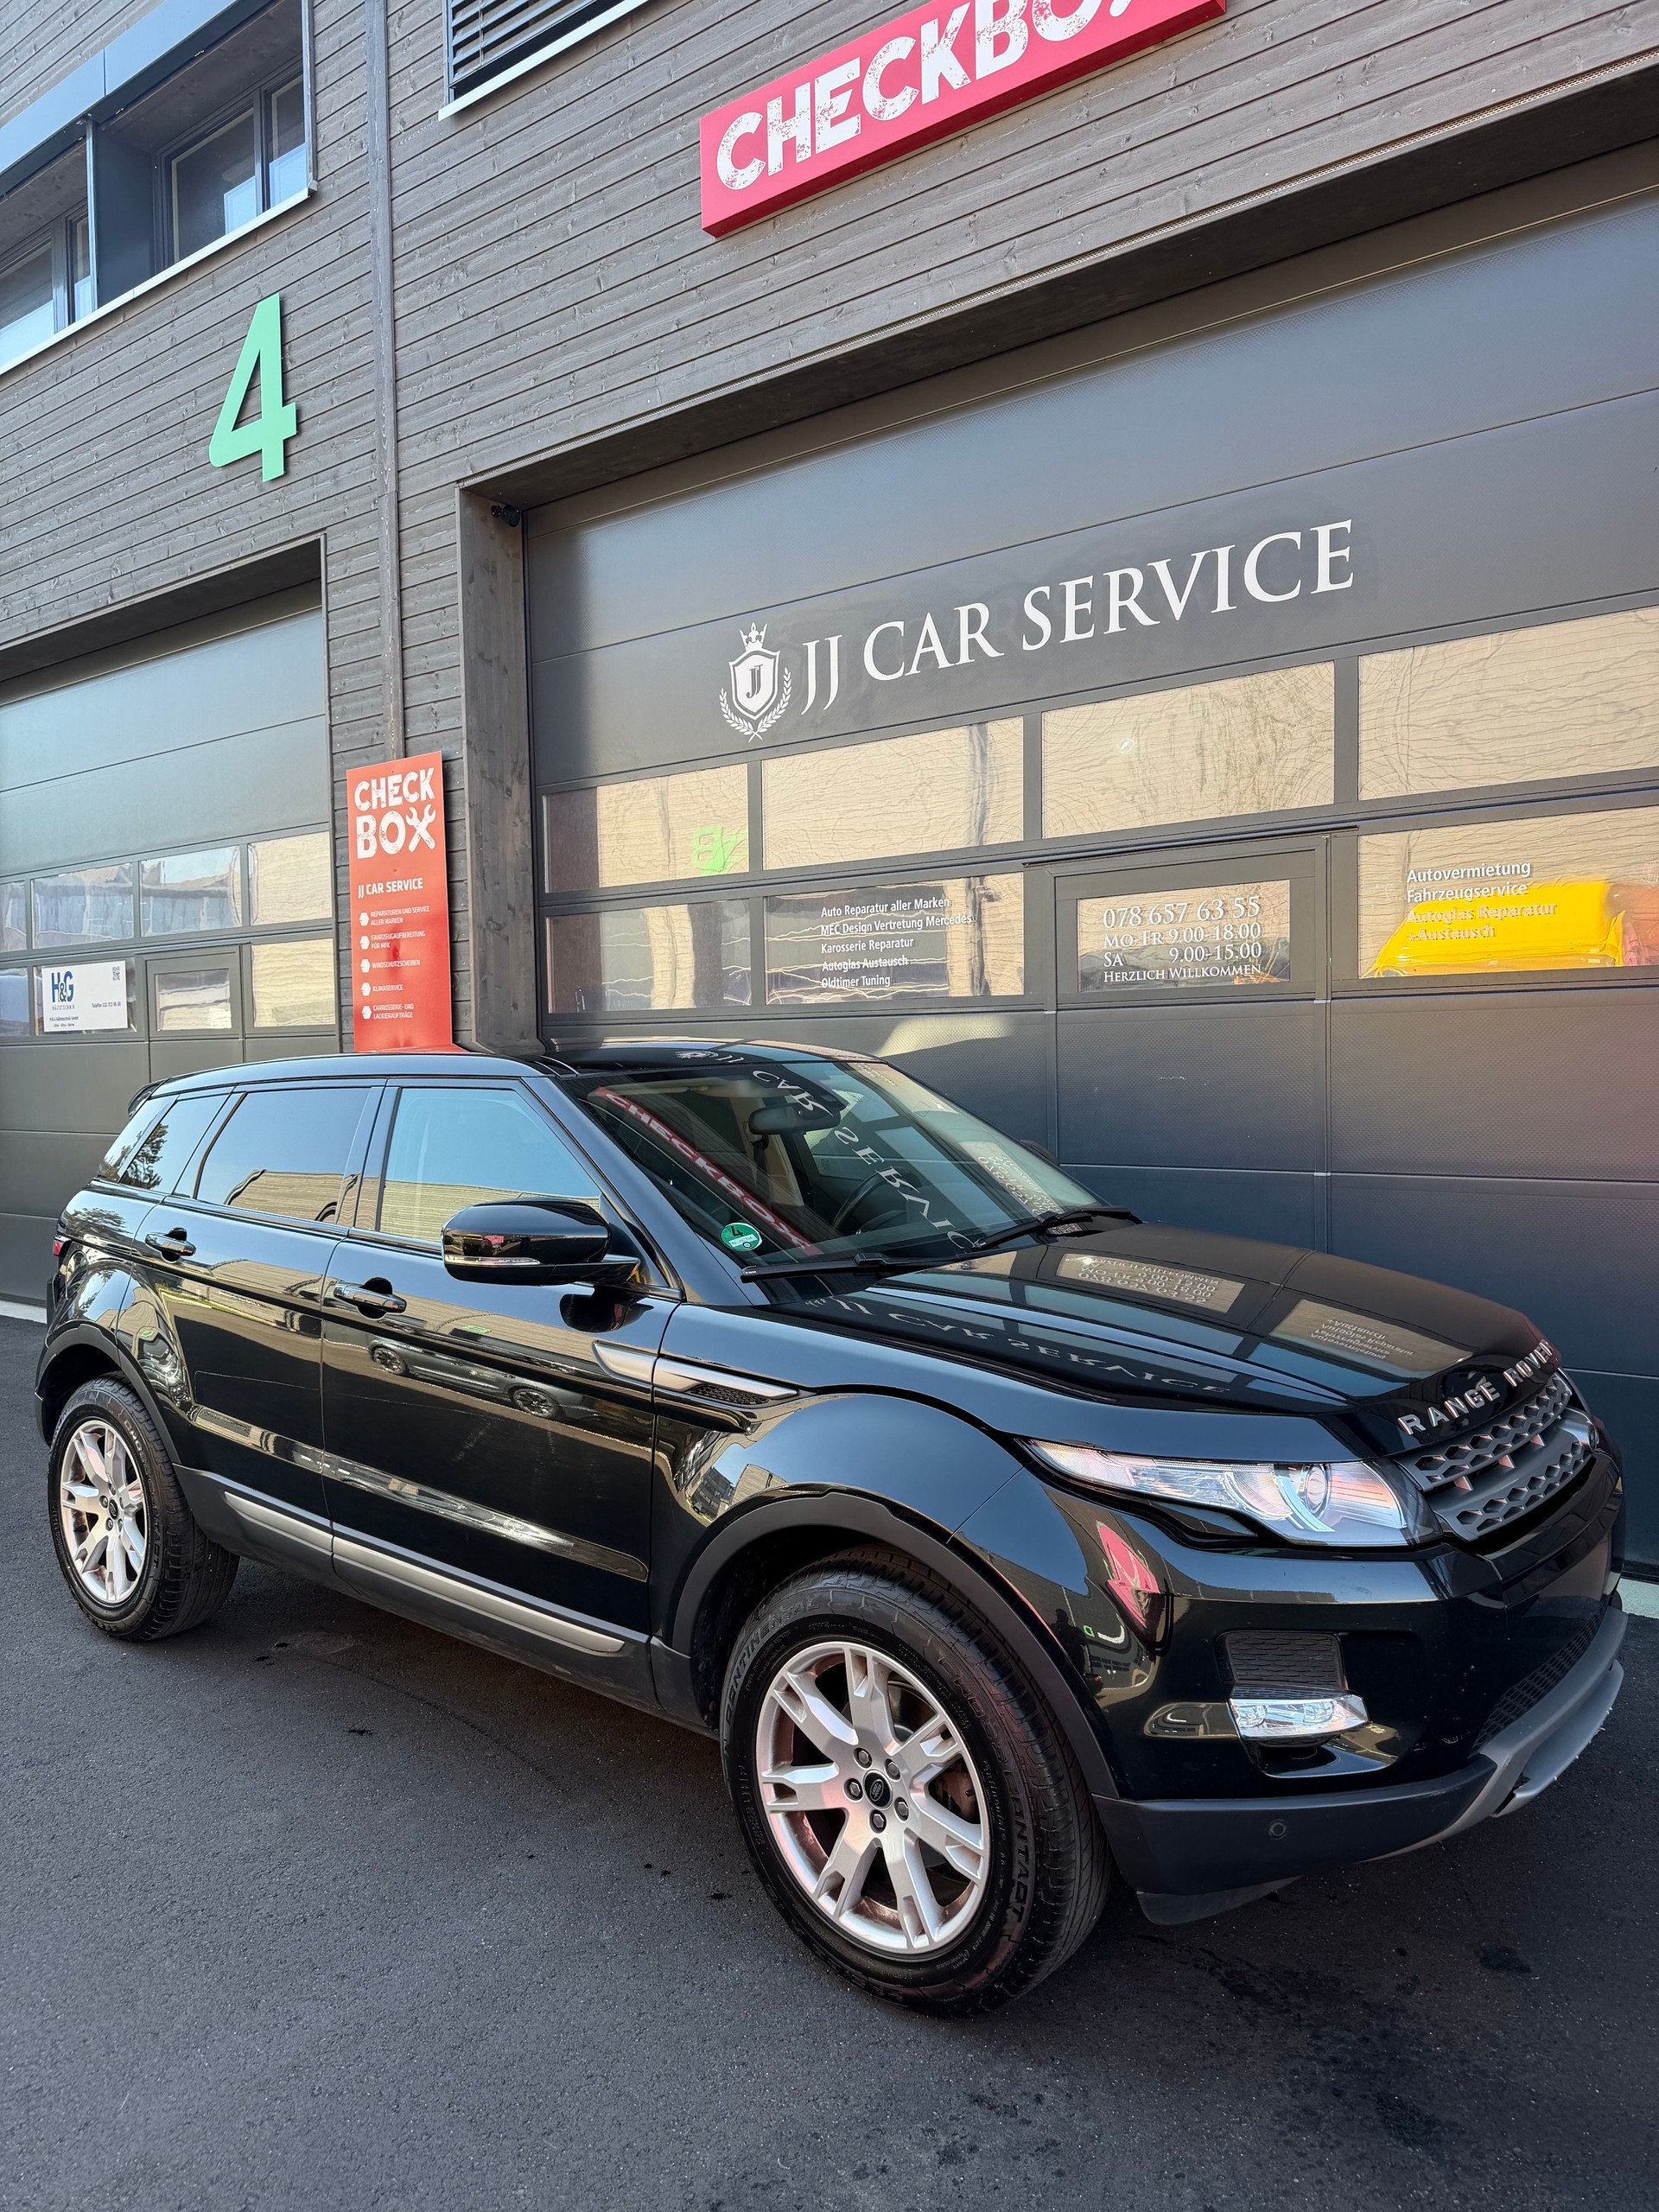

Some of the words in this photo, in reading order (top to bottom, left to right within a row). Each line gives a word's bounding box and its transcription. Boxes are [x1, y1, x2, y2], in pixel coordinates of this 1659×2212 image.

[715, 0, 1132, 191] CHECKBO
[209, 292, 297, 483] 4
[801, 634, 842, 715] JJ
[864, 602, 1004, 681] CAR
[1021, 519, 1355, 652] SERVICE
[354, 767, 435, 811] CHECK
[356, 804, 436, 860] BOX
[1407, 862, 1531, 883] Autovermietung
[358, 884, 365, 899] JJ
[366, 882, 384, 895] CAR
[385, 877, 423, 893] SERVICE
[1407, 882, 1528, 903] Fahrzeugservice
[821, 906, 842, 918] Auto
[844, 903, 888, 918] Reparatur
[891, 899, 911, 912] aller
[914, 897, 950, 910] Marken
[1103, 906, 1141, 928] 078
[1148, 902, 1188, 925] 657
[1197, 899, 1224, 921] 63
[1232, 895, 1261, 918] 55
[1407, 908, 1474, 925] Autoglas
[1478, 904, 1557, 921] Reparatur
[821, 924, 840, 936] MEC
[842, 921, 873, 935] Design
[874, 918, 923, 931] Vertretung
[925, 914, 972, 928] Mercedes
[822, 940, 867, 954] Karosserie
[868, 938, 914, 951] Reparatur
[822, 959, 862, 973] Autoglas
[862, 955, 908, 968] Austausch
[51, 971, 74, 1002] H&G
[822, 976, 859, 988] Oldtimer
[861, 975, 891, 988] Tuning
[1397, 1382, 1501, 1435] RANGE
